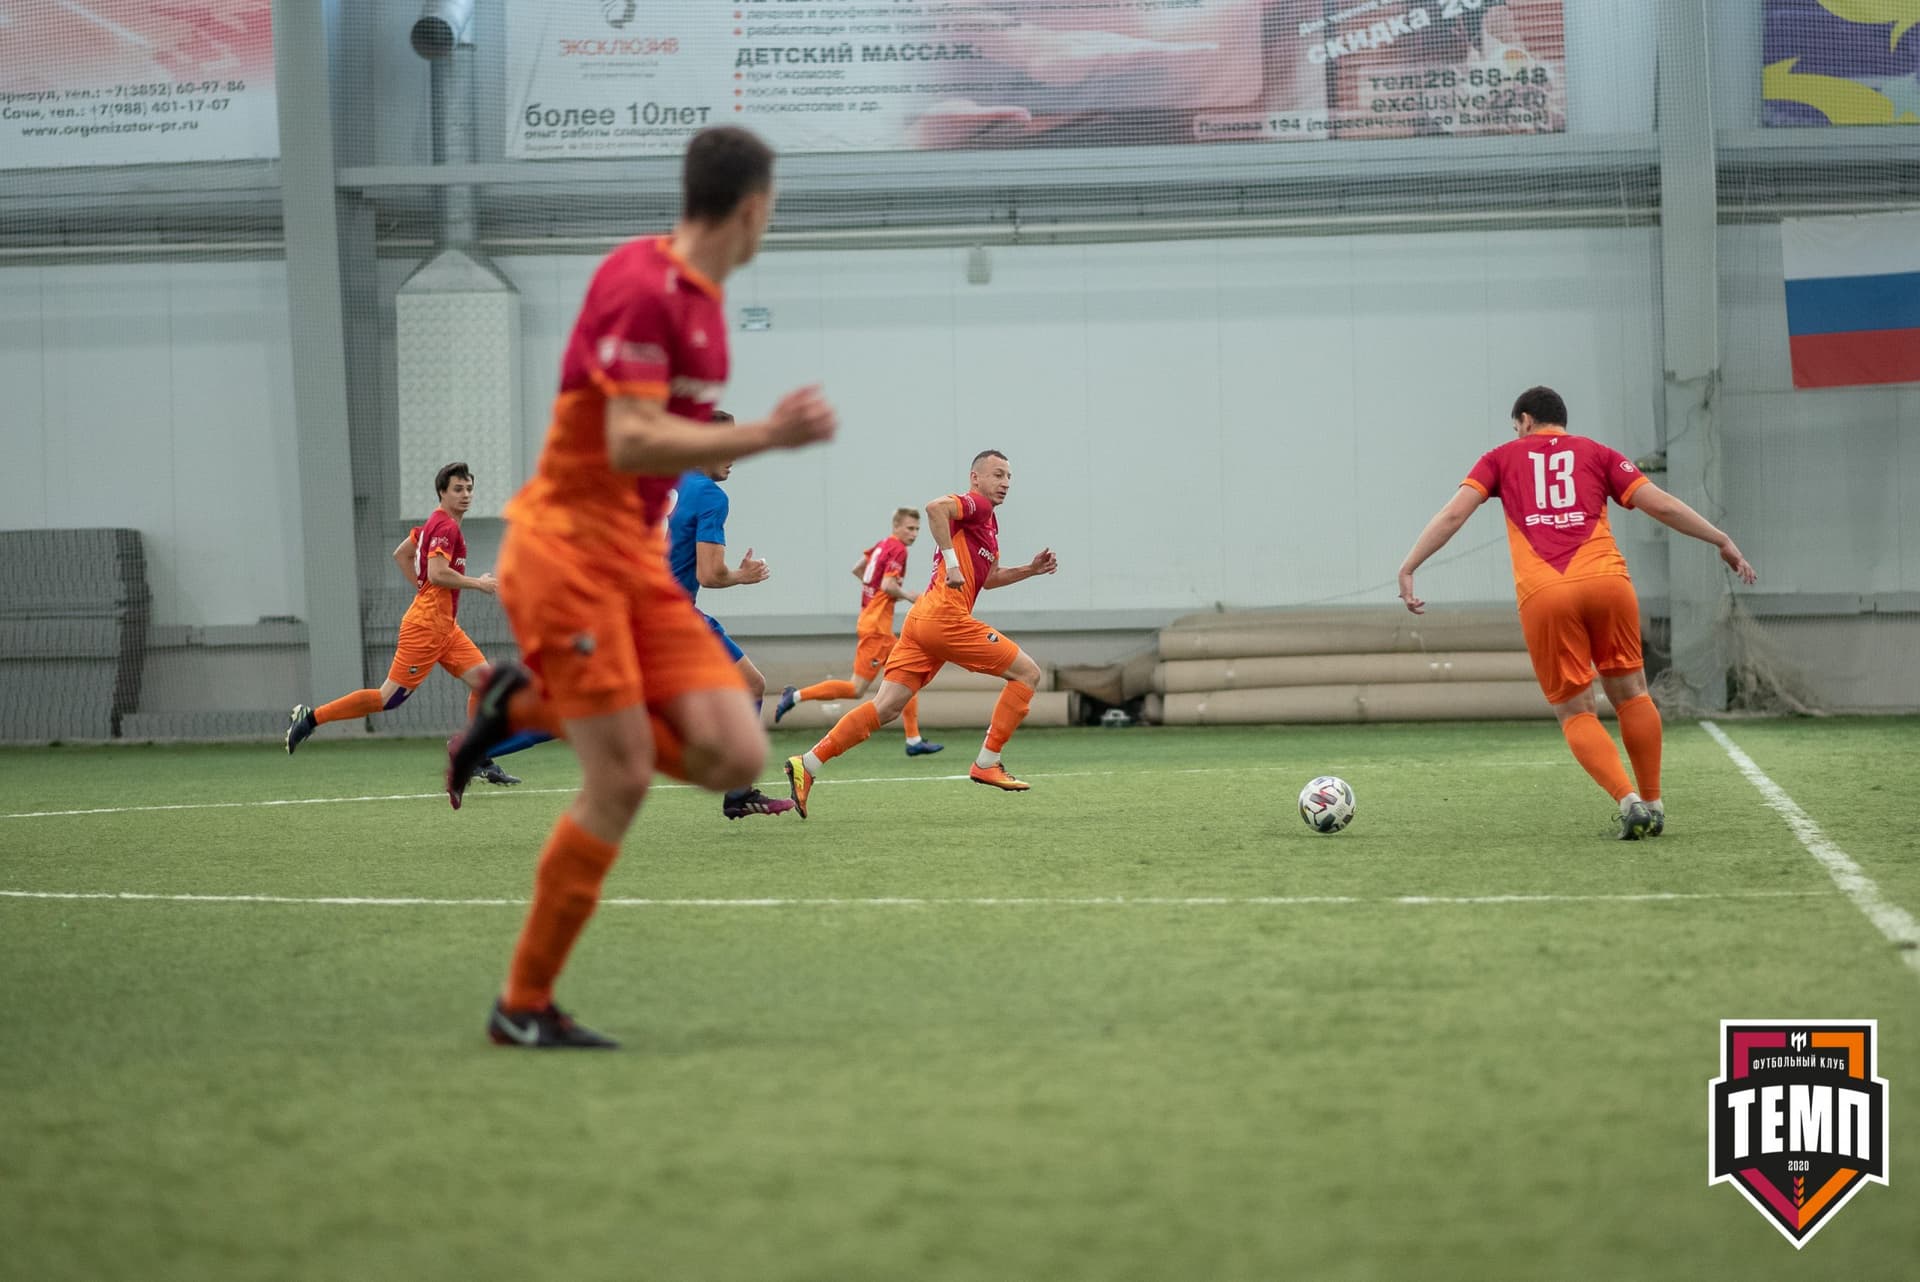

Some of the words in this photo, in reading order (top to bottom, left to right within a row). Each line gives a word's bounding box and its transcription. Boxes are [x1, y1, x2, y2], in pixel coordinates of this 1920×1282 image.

[735, 42, 853, 67] ДЕТСКИЙ
[525, 103, 616, 127] более
[627, 102, 711, 125] 10лет
[1268, 118, 1300, 131] 194
[1528, 450, 1576, 509] 13
[1525, 512, 1585, 526] SEUS
